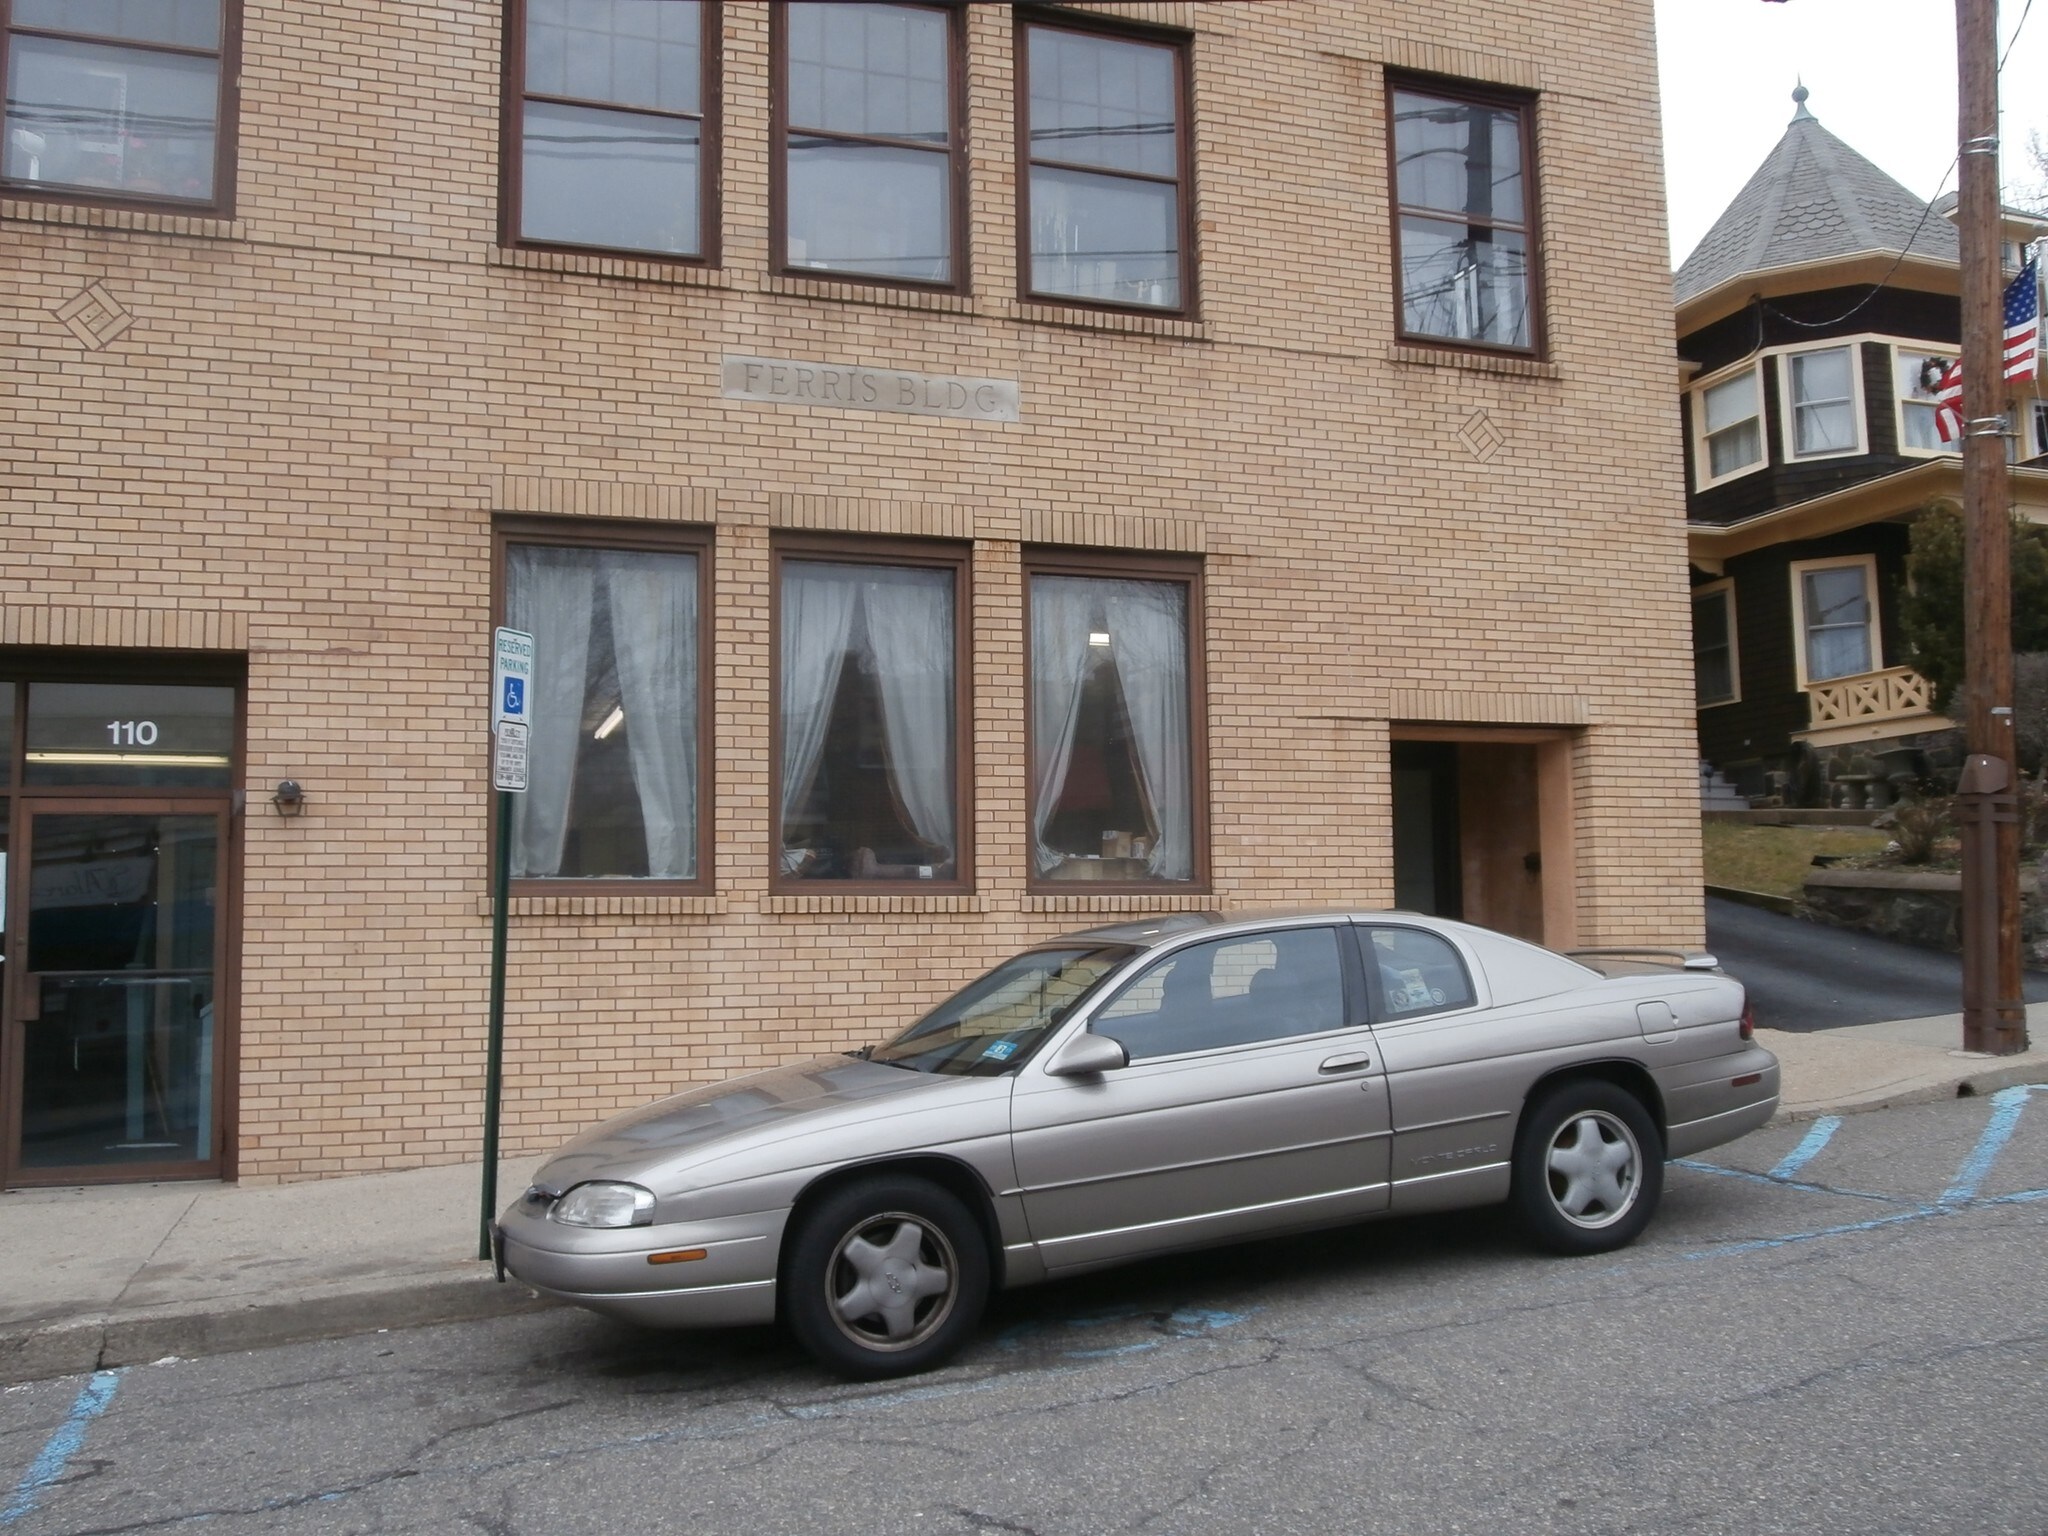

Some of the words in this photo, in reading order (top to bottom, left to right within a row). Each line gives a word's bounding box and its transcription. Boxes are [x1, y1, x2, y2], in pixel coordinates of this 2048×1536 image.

[742, 363, 877, 403] FERRIS
[498, 638, 531, 657] RESERVED
[500, 656, 529, 675] PARKING
[106, 720, 158, 746] 110
